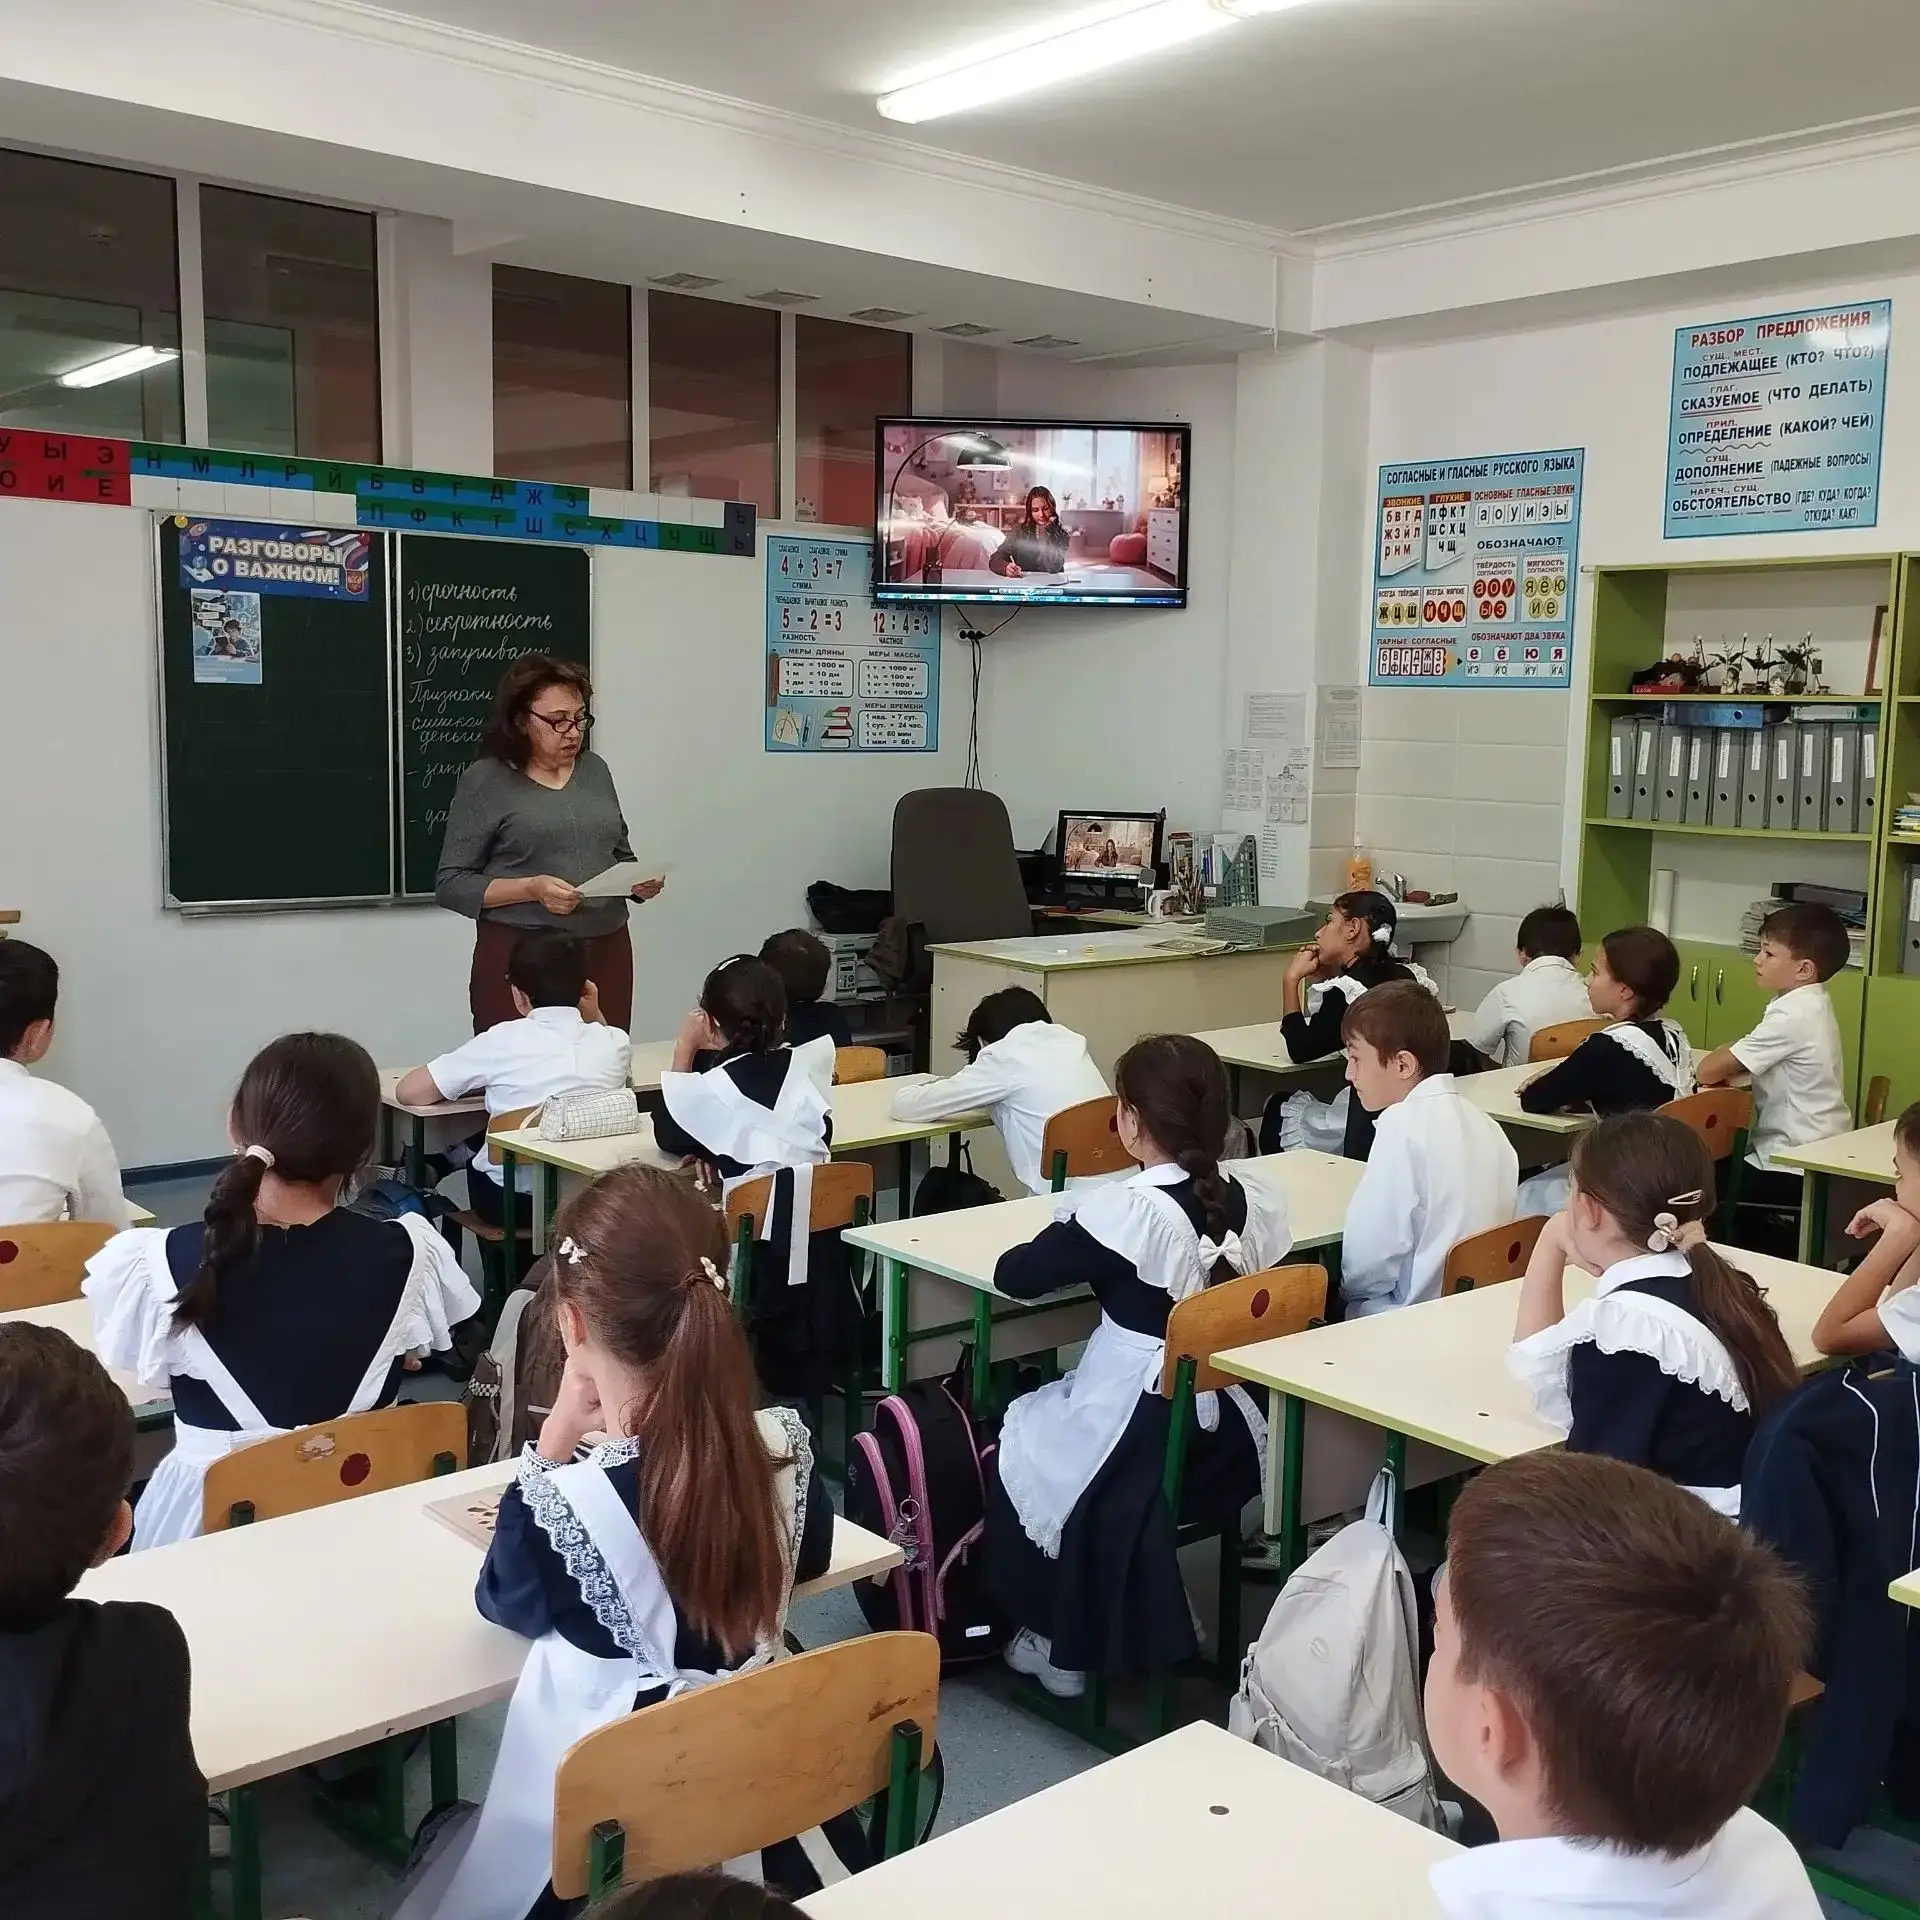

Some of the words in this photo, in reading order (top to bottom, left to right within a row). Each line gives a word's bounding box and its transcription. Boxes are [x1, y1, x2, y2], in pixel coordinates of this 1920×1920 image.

[1692, 328, 1744, 347] РАЗБОР
[1756, 311, 1870, 339] ПРЕДЛОЖЕНИЯ
[1683, 355, 1778, 379] ПОДЛЕЖАЩЕЕ
[1786, 351, 1824, 369] (КТО?
[1834, 345, 1874, 360] ЧТО?)
[1681, 391, 1759, 411] СКАЗУЕМОЕ
[1768, 386, 1800, 404] (ЧТО
[1809, 379, 1872, 399] ДЕЛАТЬ)
[1678, 424, 1771, 445] ОПРЕДЕЛЕНИЕ
[1780, 418, 1837, 438] (КАКОЙ?
[1841, 414, 1874, 429] ЧЕЙ)
[45, 442, 66, 460] Ы
[98, 447, 113, 464] Э
[148, 452, 160, 469] Н
[193, 456, 209, 473] М
[241, 461, 255, 478] Л
[286, 465, 299, 481] Р
[371, 473, 384, 488] Б
[413, 480, 424, 495] В
[491, 485, 503, 500] Д
[528, 488, 542, 505] Ж
[1387, 469, 1437, 484] СОГЛАСНЫЕ
[1440, 470, 1445, 480] И
[1448, 464, 1488, 479] ГЛАСНЫЕ
[1493, 460, 1539, 476] РУССКОГО
[1543, 456, 1575, 471] ЯЗЫКА
[1675, 461, 1763, 481] ДОПОЛНЕНИЕ
[1770, 457, 1821, 474] (ПАДЕЖНЫЕ
[1827, 452, 1871, 467] ВОПРОСЫ)
[1435, 493, 1465, 504] ГЛУХИЕ
[1475, 490, 1513, 500] ОСНОВНЫЕ
[1517, 486, 1550, 498] ГЛАСНЫЕ
[1552, 484, 1575, 495] ЗВУКИ
[1673, 492, 1791, 511] ОБСТОЯТЕЛЬСТВО
[49, 475, 63, 492] И
[99, 480, 112, 497] Е
[371, 504, 384, 520] П
[411, 508, 426, 523] Ф
[452, 511, 464, 527] К
[492, 514, 503, 528] Т
[526, 518, 540, 534] Ш
[564, 521, 576, 535] С
[600, 525, 612, 540] Х
[208, 536, 343, 564] РАЗГОВОРЫ
[1477, 537, 1563, 549] ОБОЗНАЧАЮТ
[213, 559, 229, 575] О
[235, 561, 339, 585] ВАЖНОМ!
[1476, 561, 1516, 569] ТВЁРДОСТЬ
[422, 583, 517, 612] срочность
[792, 581, 812, 590] СУММА
[426, 614, 552, 642] секретность
[782, 634, 816, 642] РАЗНОСТЬ
[879, 637, 903, 645] ЧАСТНОЕ
[1472, 632, 1521, 641] ОБОЗНАЧАЮТ
[1524, 633, 1540, 641] ДВА
[1543, 632, 1565, 640] ЗВУКА
[409, 679, 494, 714] Признаки
